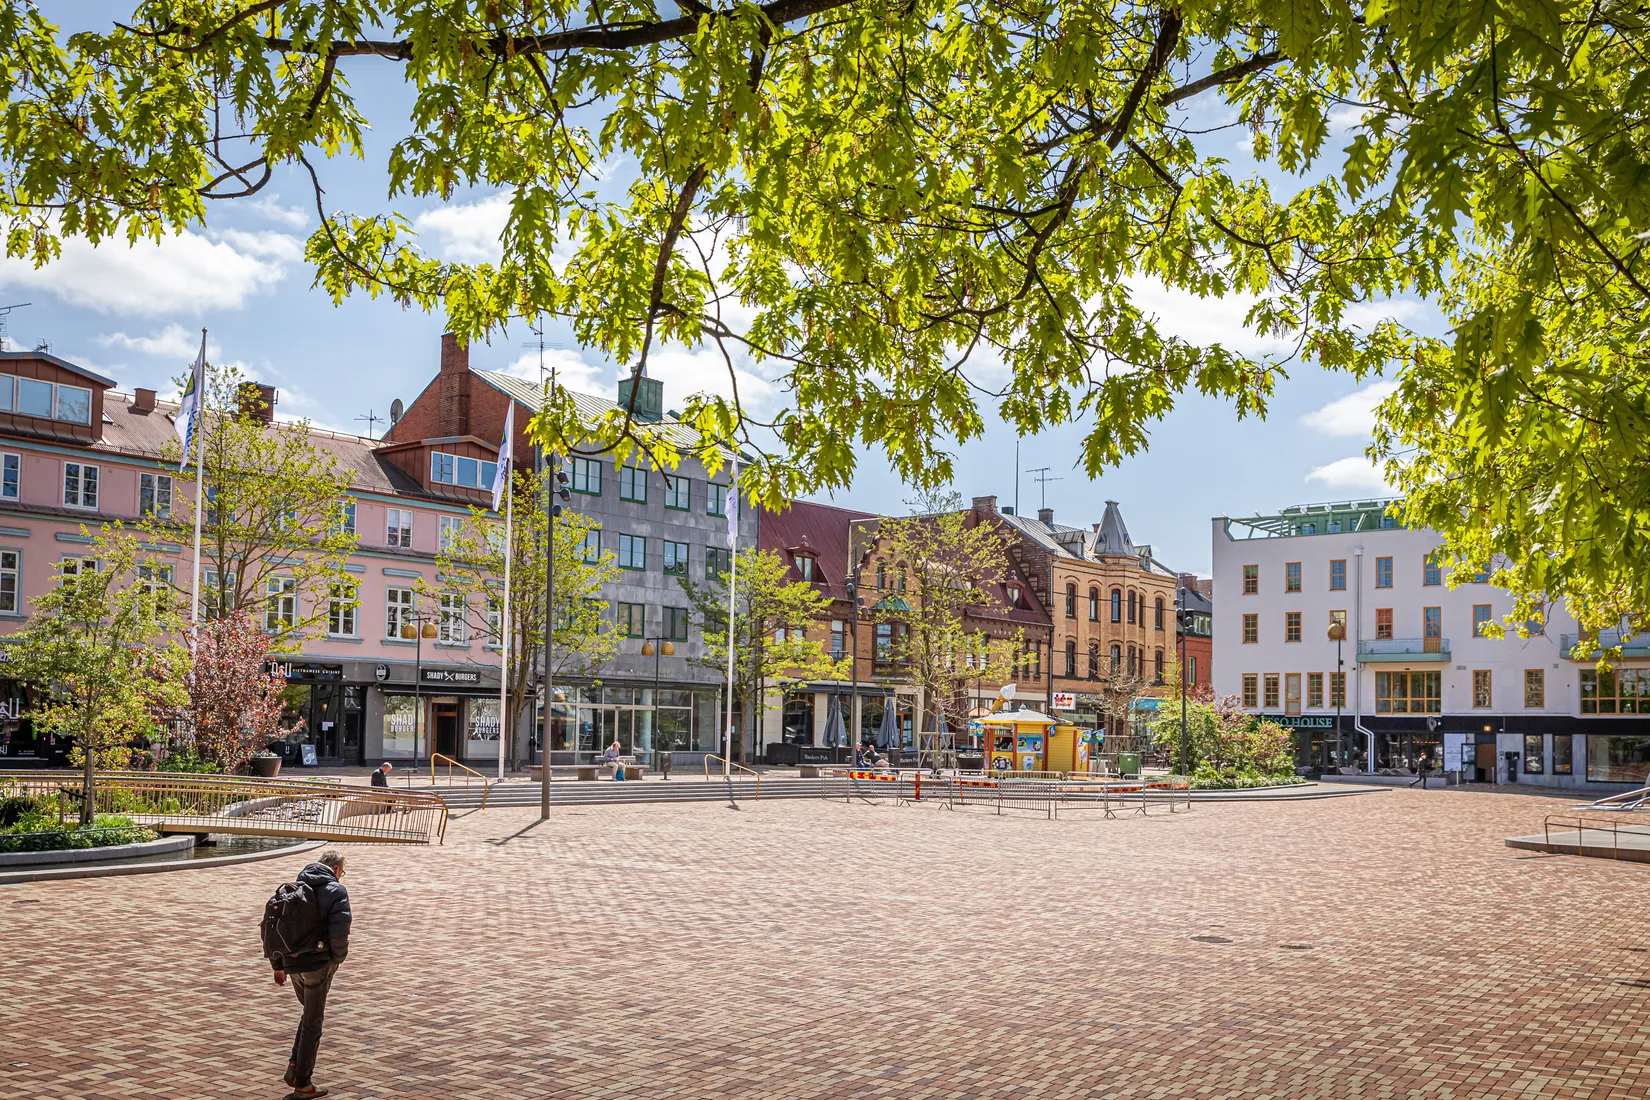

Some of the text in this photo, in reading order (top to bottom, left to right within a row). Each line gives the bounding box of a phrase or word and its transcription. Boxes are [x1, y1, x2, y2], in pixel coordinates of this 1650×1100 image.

[426, 671, 477, 681] SHADY BURGERS
[475, 716, 500, 727] SHADY
[1291, 717, 1333, 728] HOUSE
